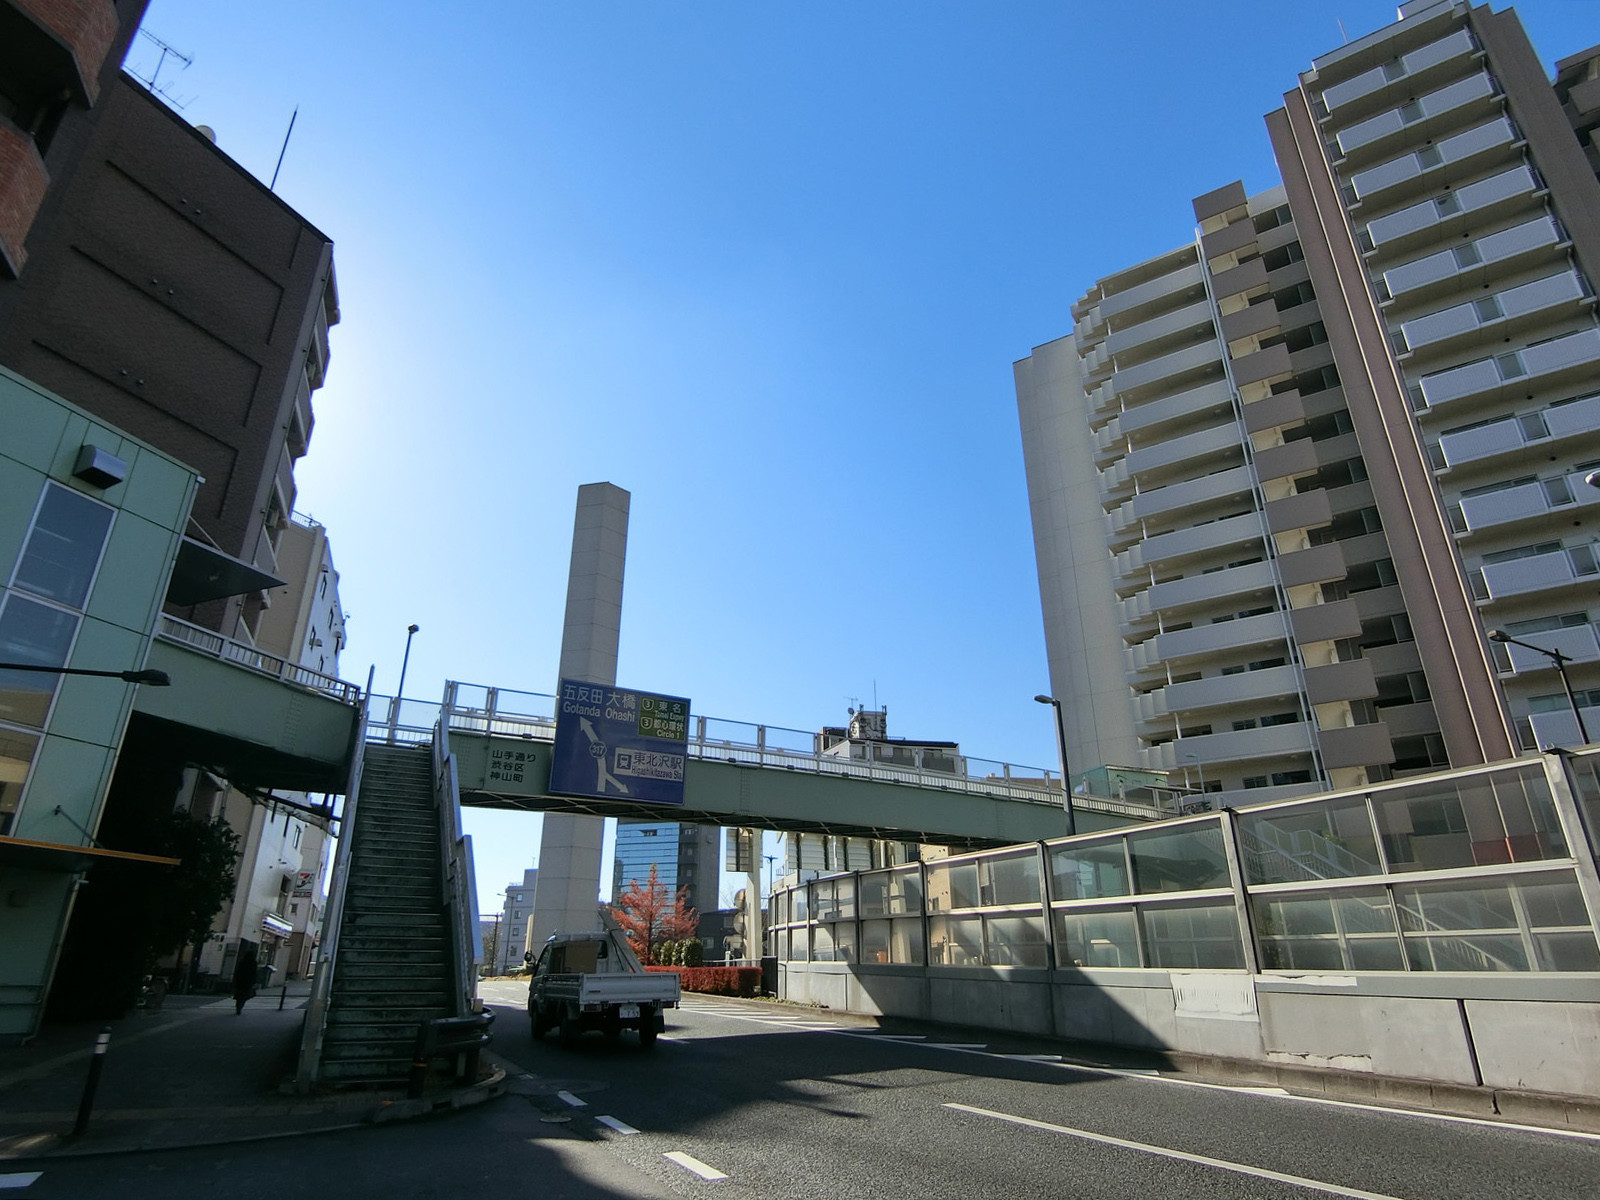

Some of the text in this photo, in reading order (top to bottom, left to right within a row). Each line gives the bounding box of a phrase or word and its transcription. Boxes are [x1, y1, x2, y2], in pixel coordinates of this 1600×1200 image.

[564, 684, 636, 709] 五反田 大橋
[563, 701, 635, 722] Gotanda Ohashi
[492, 749, 536, 762] 山手通り
[592, 744, 604, 754] 317
[491, 760, 524, 772] 渋谷区
[633, 751, 683, 770] 東北沢駅
[490, 771, 524, 783] 神山町
